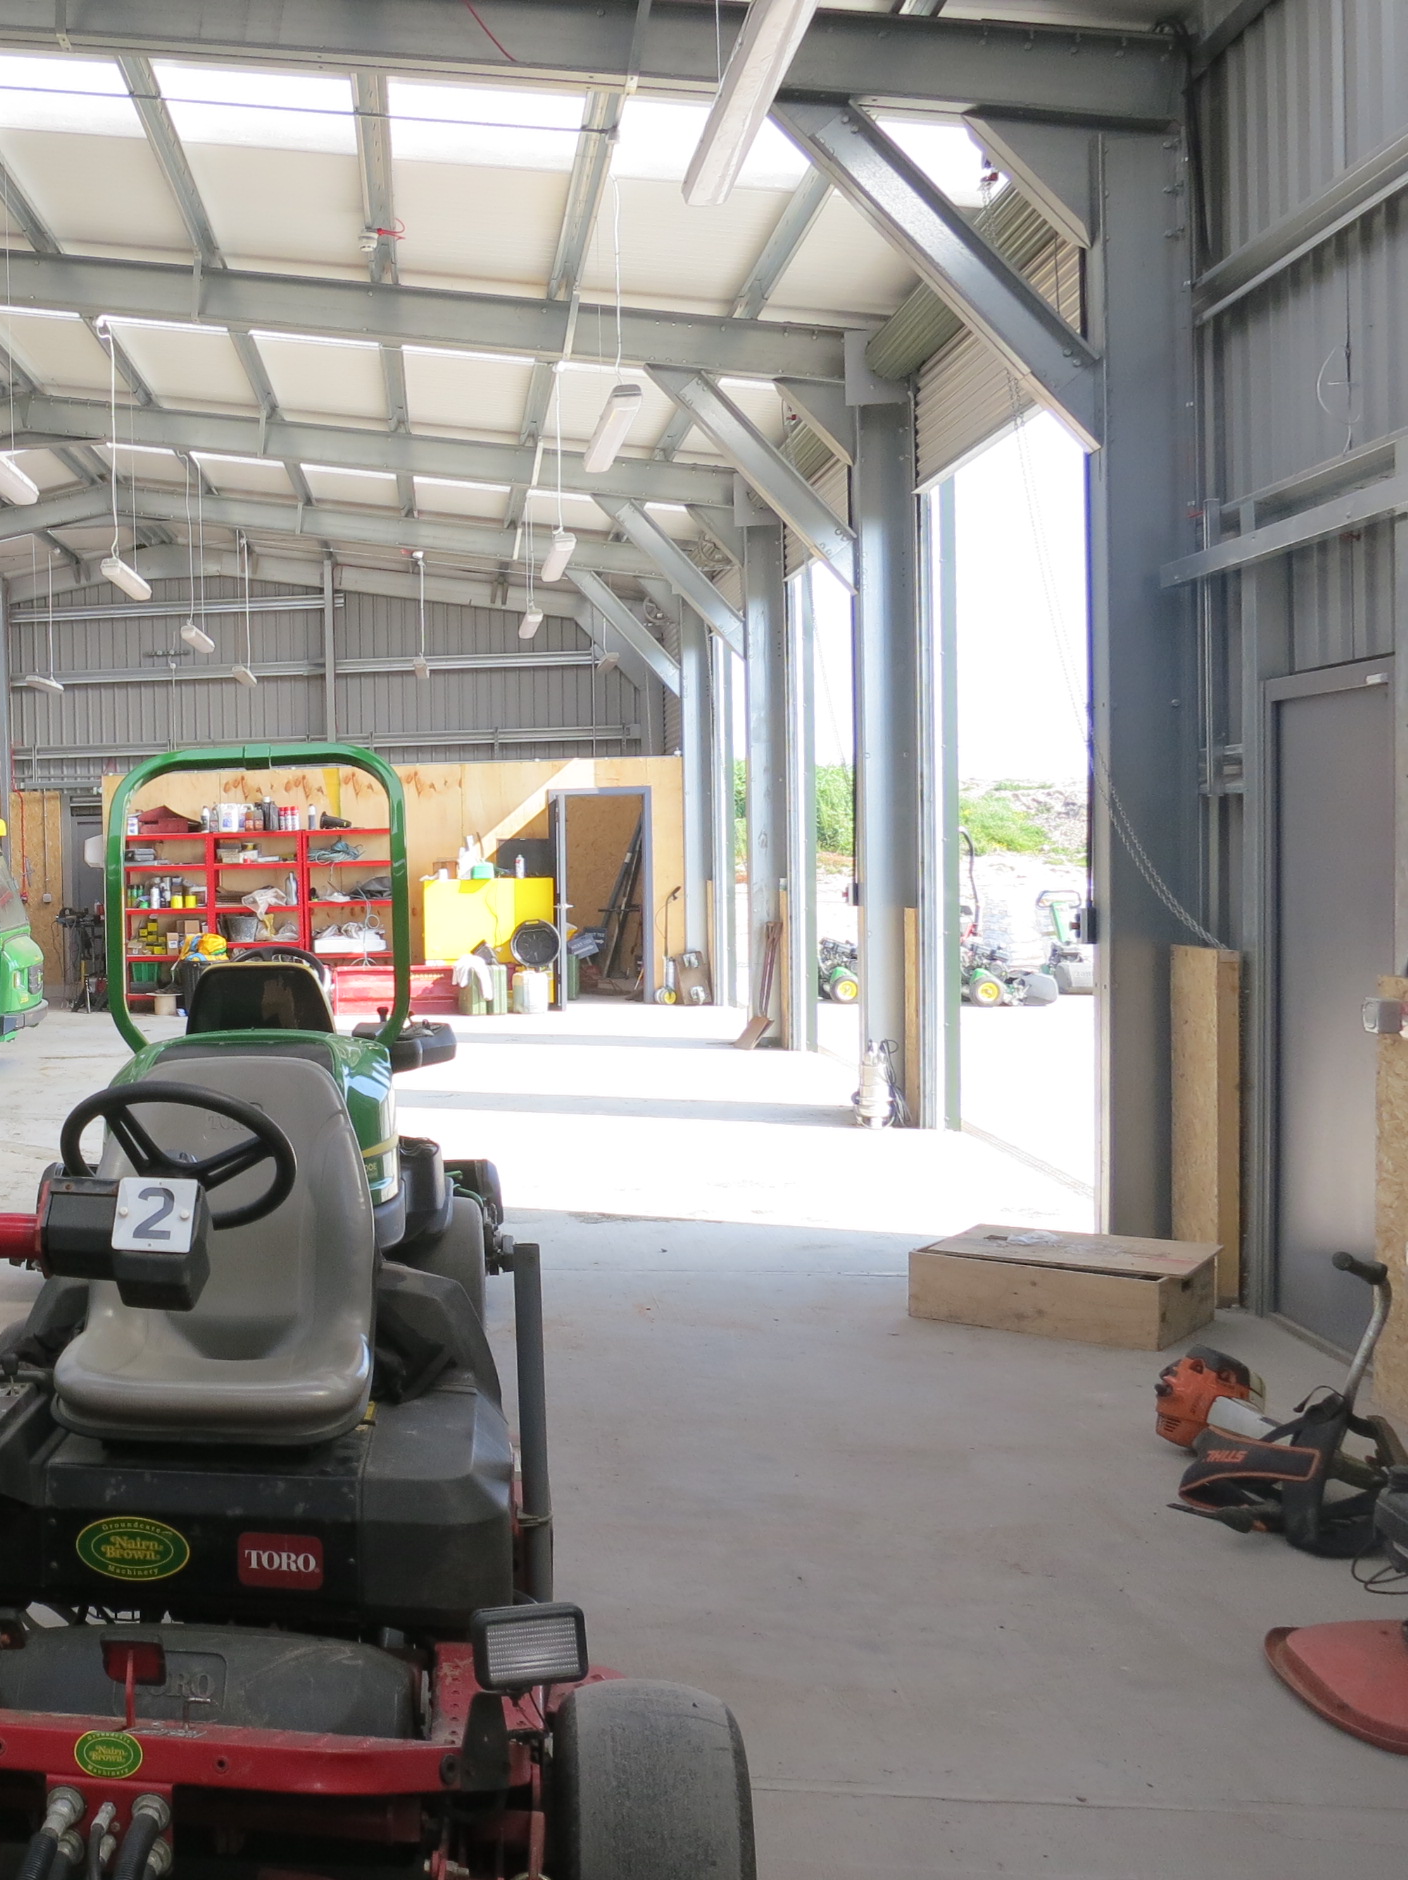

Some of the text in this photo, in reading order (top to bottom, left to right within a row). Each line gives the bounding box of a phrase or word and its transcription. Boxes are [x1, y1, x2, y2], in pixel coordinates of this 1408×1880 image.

[132, 1187, 175, 1240] 2
[102, 1521, 163, 1534] Groundcare
[110, 1535, 159, 1550] Nairn
[101, 1545, 156, 1560] Brown
[244, 1550, 316, 1572] TORO
[107, 1565, 159, 1576] Machinery
